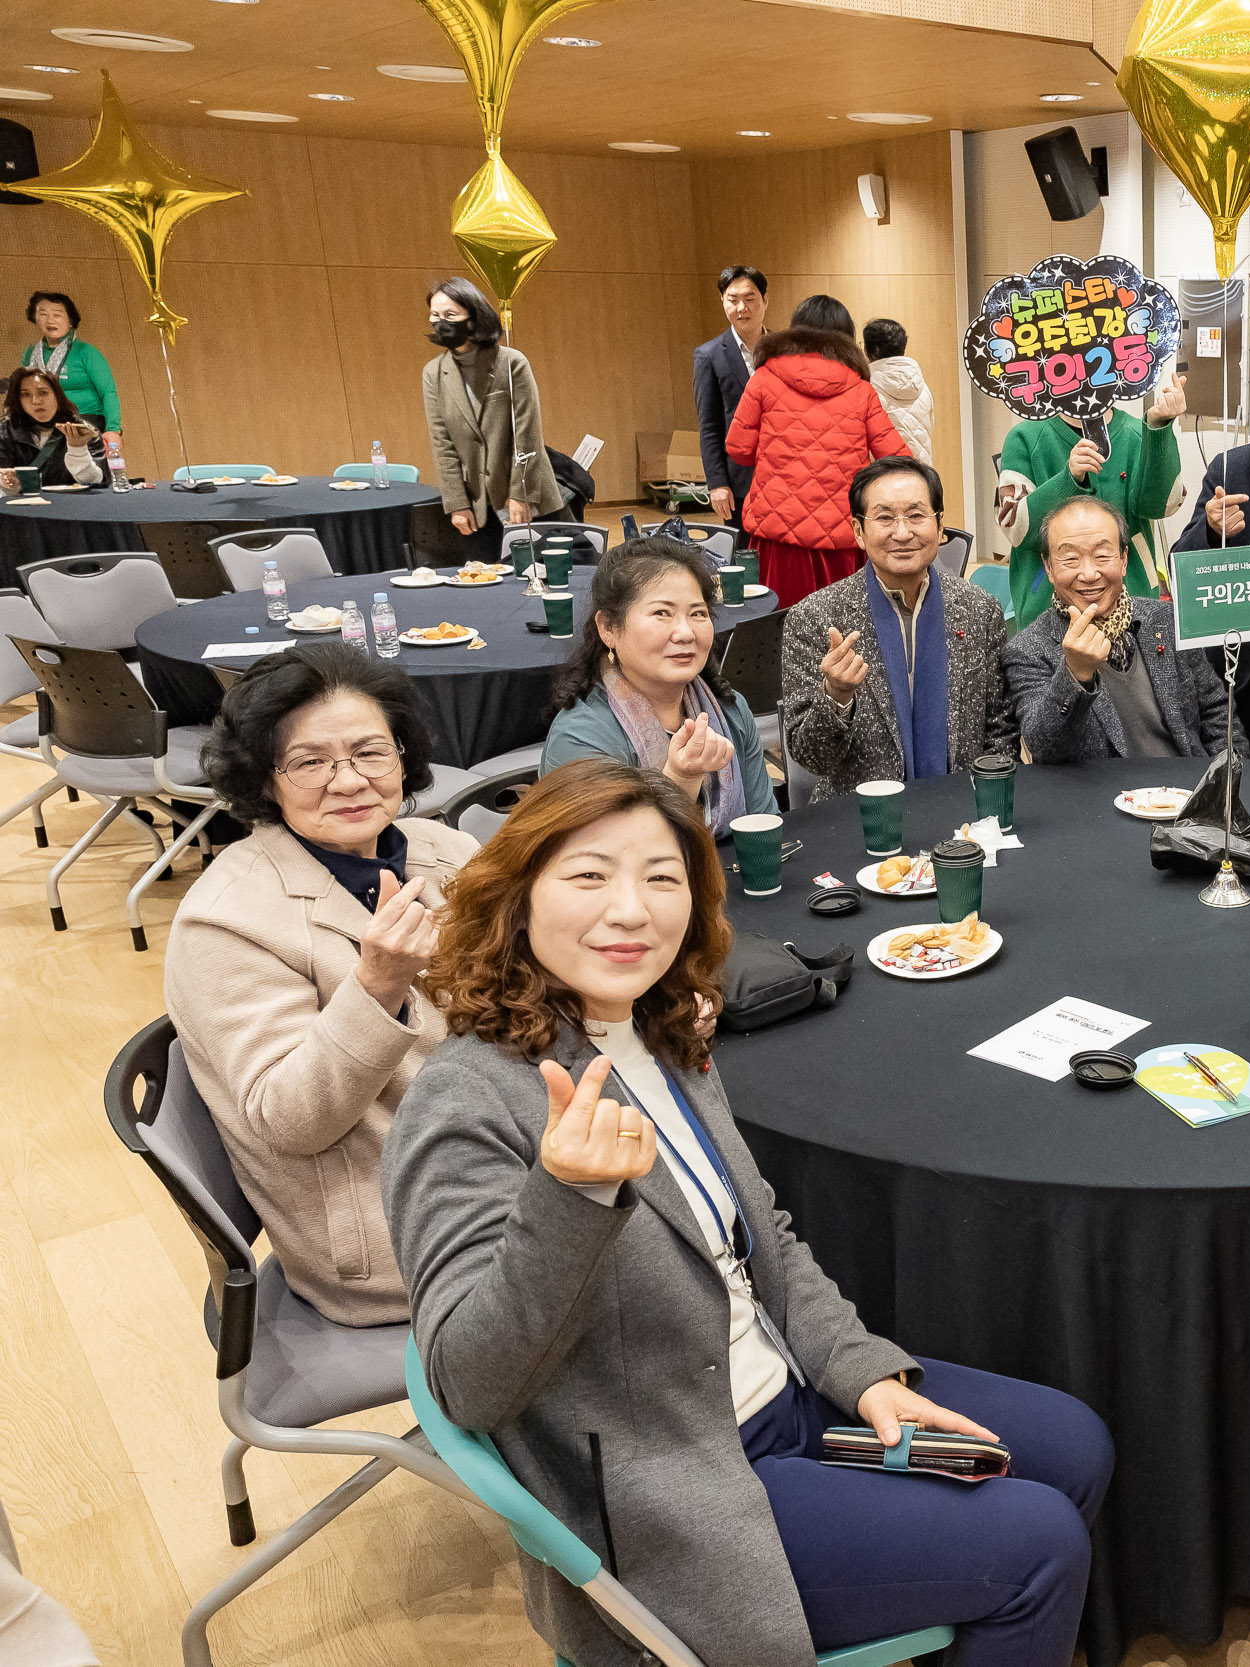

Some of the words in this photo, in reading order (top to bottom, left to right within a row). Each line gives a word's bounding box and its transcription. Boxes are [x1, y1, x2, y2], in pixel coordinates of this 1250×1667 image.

[1011, 277, 1116, 323] 슈퍼스타
[1014, 306, 1127, 357] 우주최강
[1005, 334, 1153, 404] 구의2동
[1195, 566, 1212, 575] 2025
